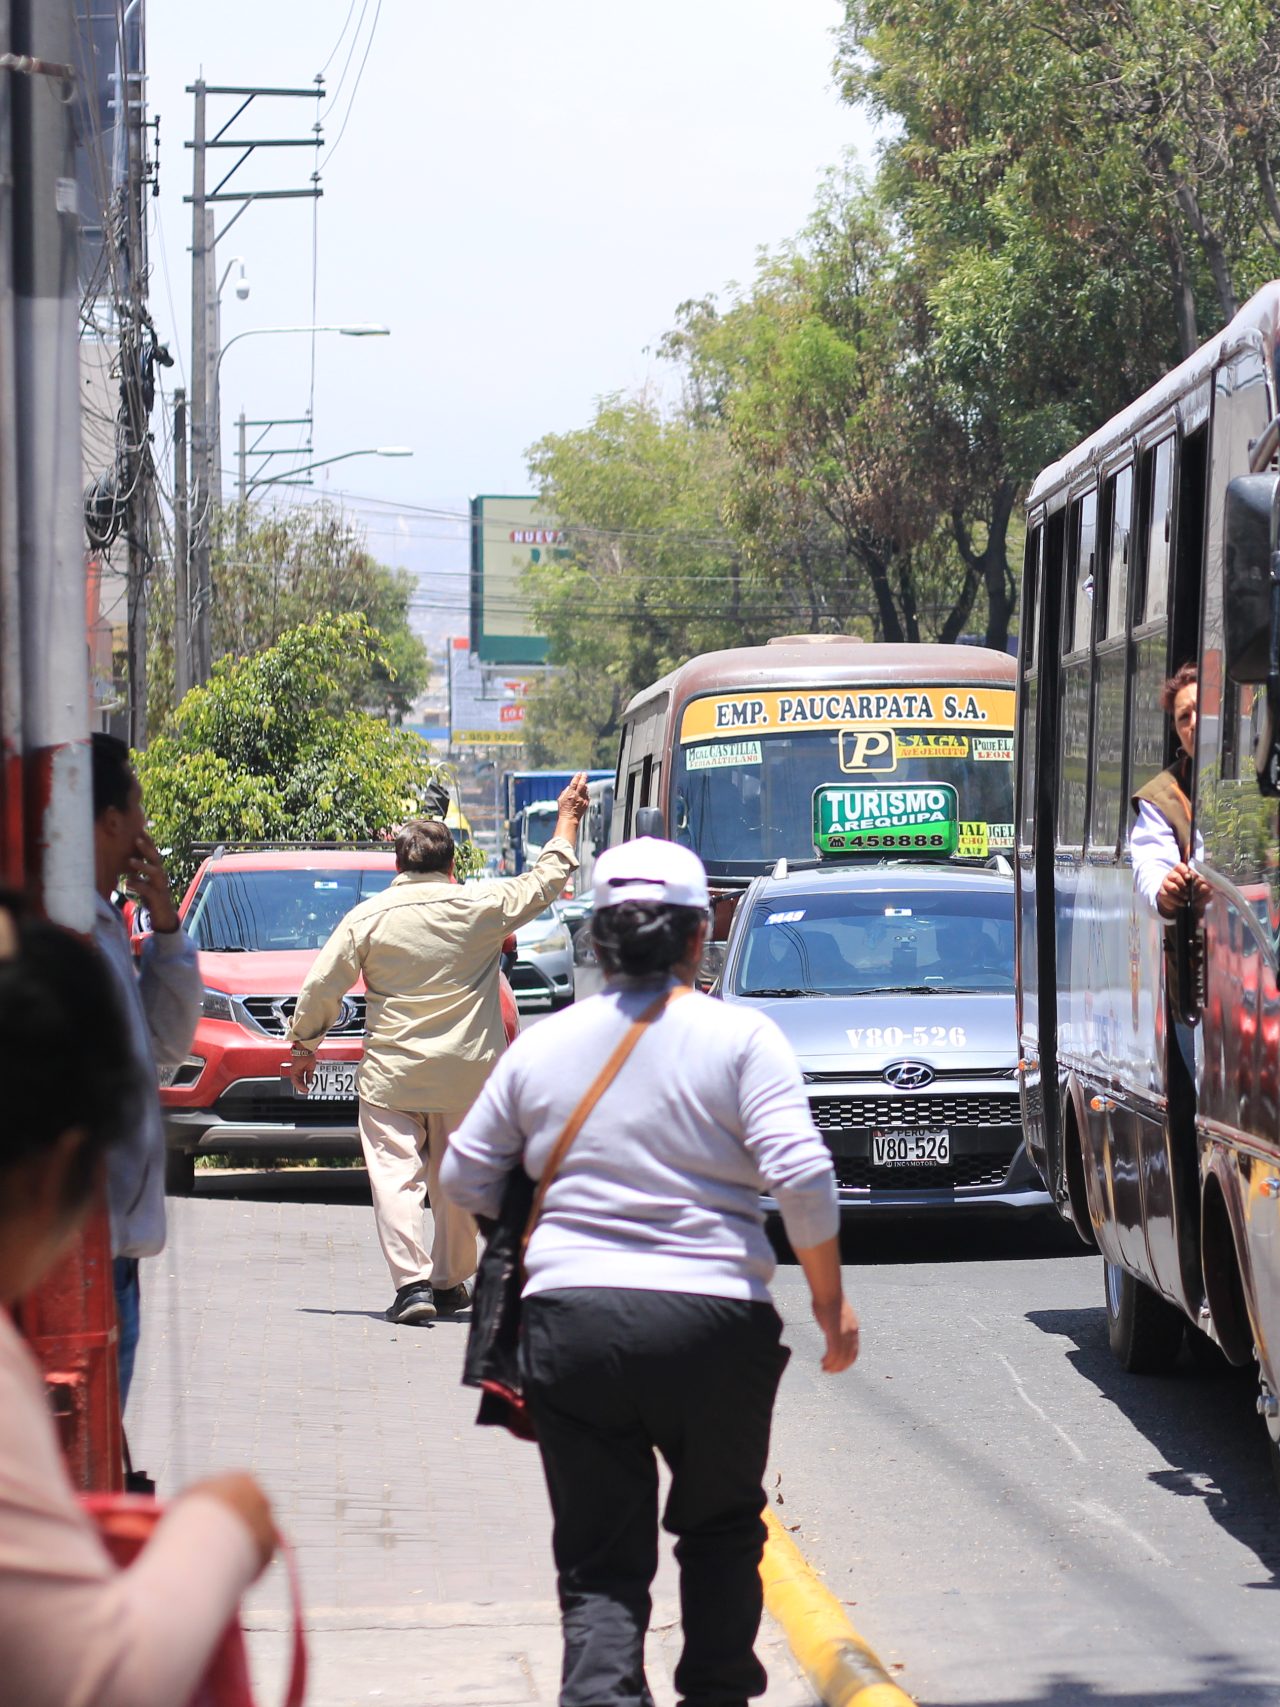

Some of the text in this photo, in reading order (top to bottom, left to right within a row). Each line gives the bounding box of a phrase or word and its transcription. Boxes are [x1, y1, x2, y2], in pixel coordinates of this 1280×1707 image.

[716, 695, 987, 727] EMP. PAUCARPATA S.A.
[826, 791, 946, 822] TURISMO
[828, 811, 945, 834] AREQUIPA
[850, 834, 945, 848] 458888
[846, 1026, 967, 1049] V80-526
[311, 1073, 358, 1092] 9V-52
[898, 1129, 925, 1137] PERU
[875, 1136, 948, 1161] V80-526
